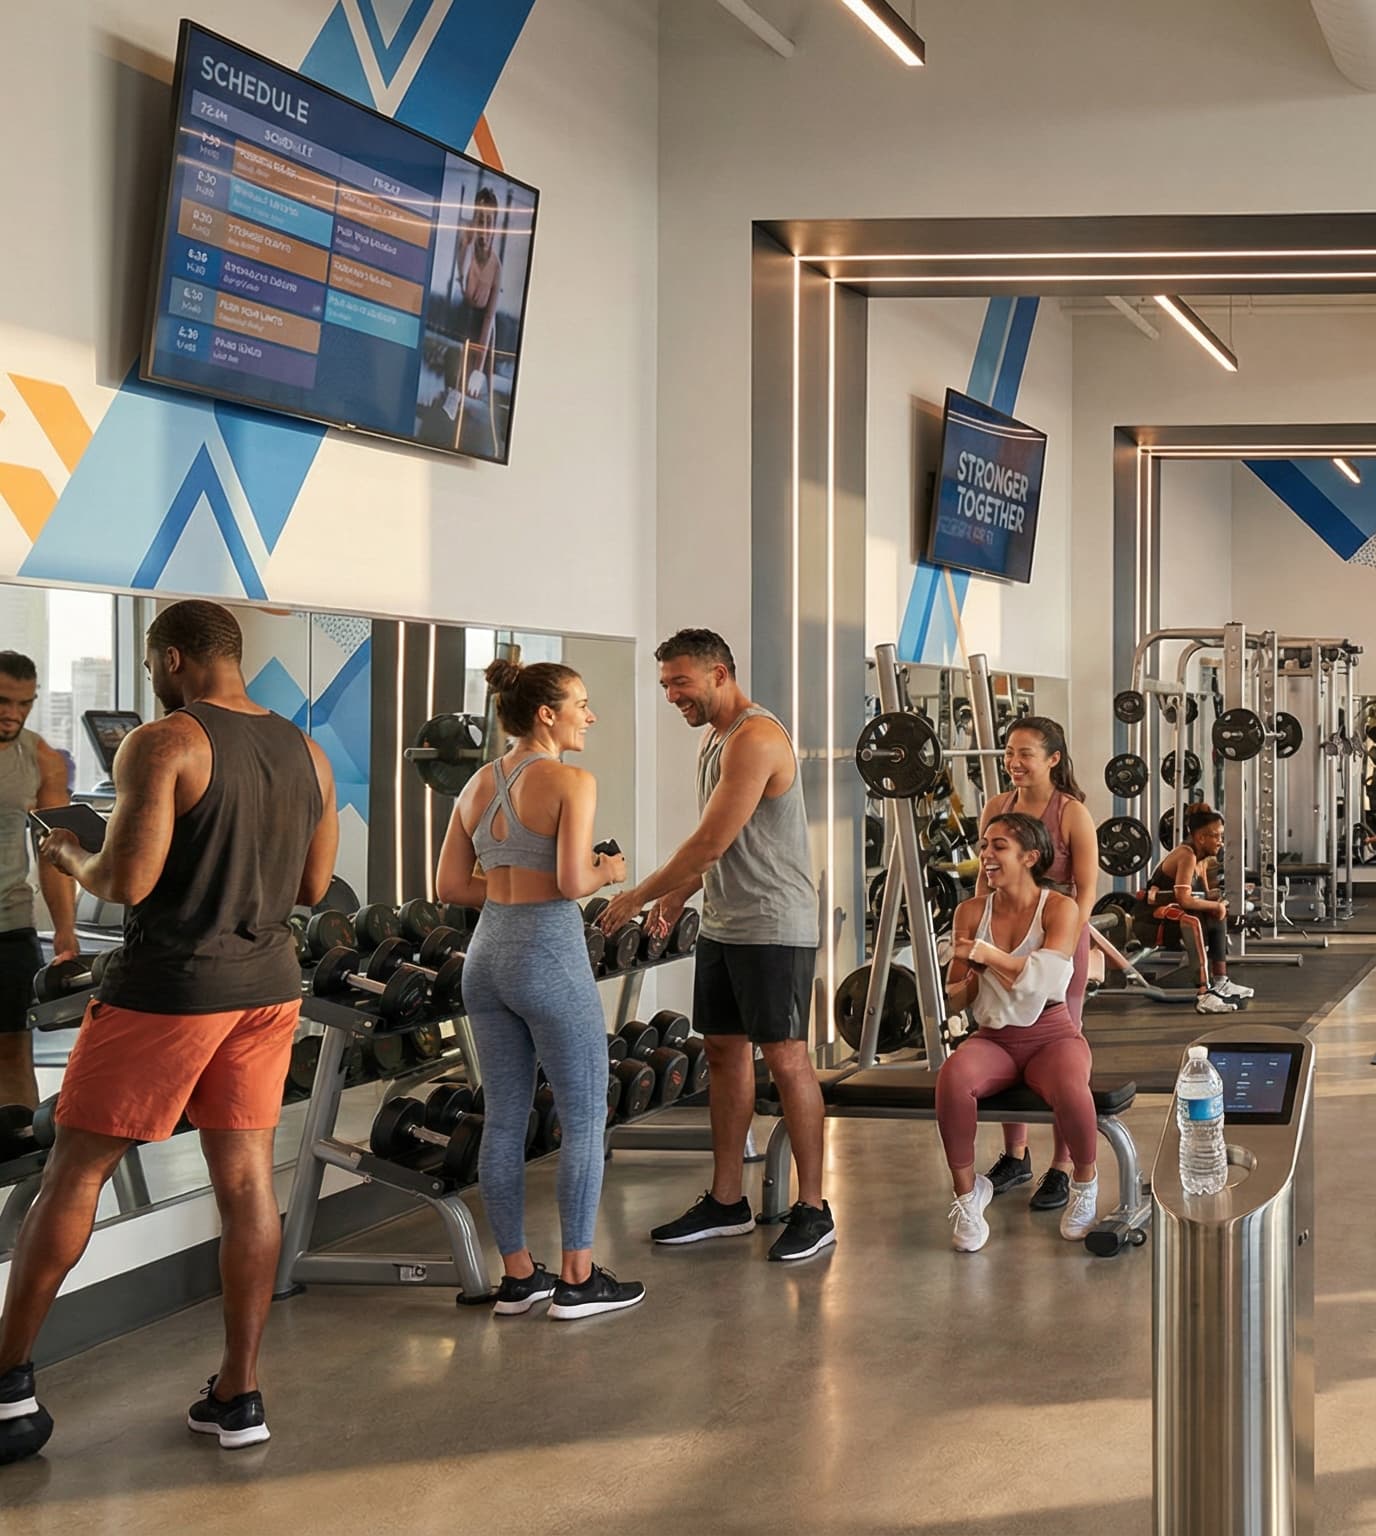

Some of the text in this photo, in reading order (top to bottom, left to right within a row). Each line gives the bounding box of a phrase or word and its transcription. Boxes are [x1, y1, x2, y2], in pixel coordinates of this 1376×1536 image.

[201, 55, 310, 124] SCHEDULE
[956, 450, 1029, 503] STRONGER
[956, 485, 1025, 534] TOGETHER
